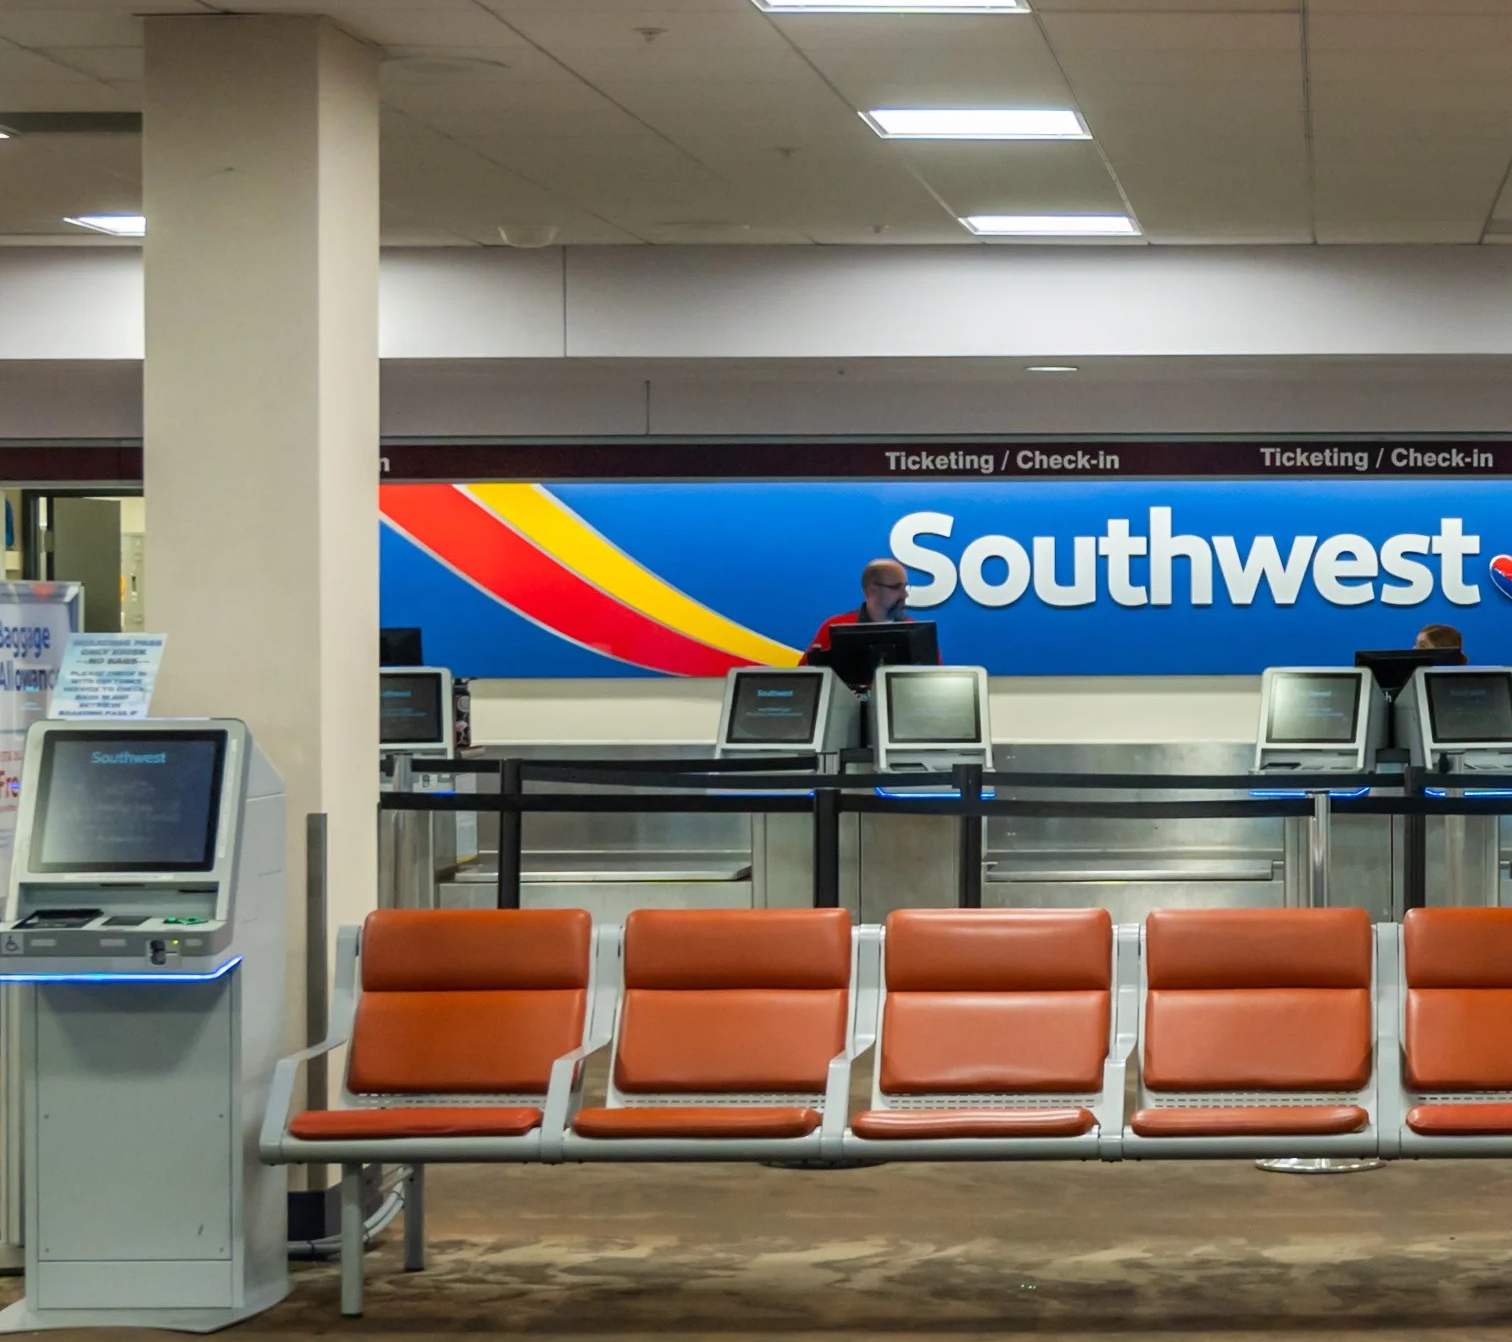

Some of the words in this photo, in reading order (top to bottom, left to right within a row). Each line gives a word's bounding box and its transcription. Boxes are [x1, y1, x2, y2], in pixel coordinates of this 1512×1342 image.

[885, 450, 995, 474] Ticketing
[1001, 451, 1010, 471] /
[1016, 450, 1120, 471] Check-in
[1260, 447, 1369, 471] Ticketing
[1375, 448, 1385, 469] /
[1391, 447, 1494, 469] Check-in
[889, 506, 1481, 607] Southwest
[91, 750, 167, 763] Southwest
